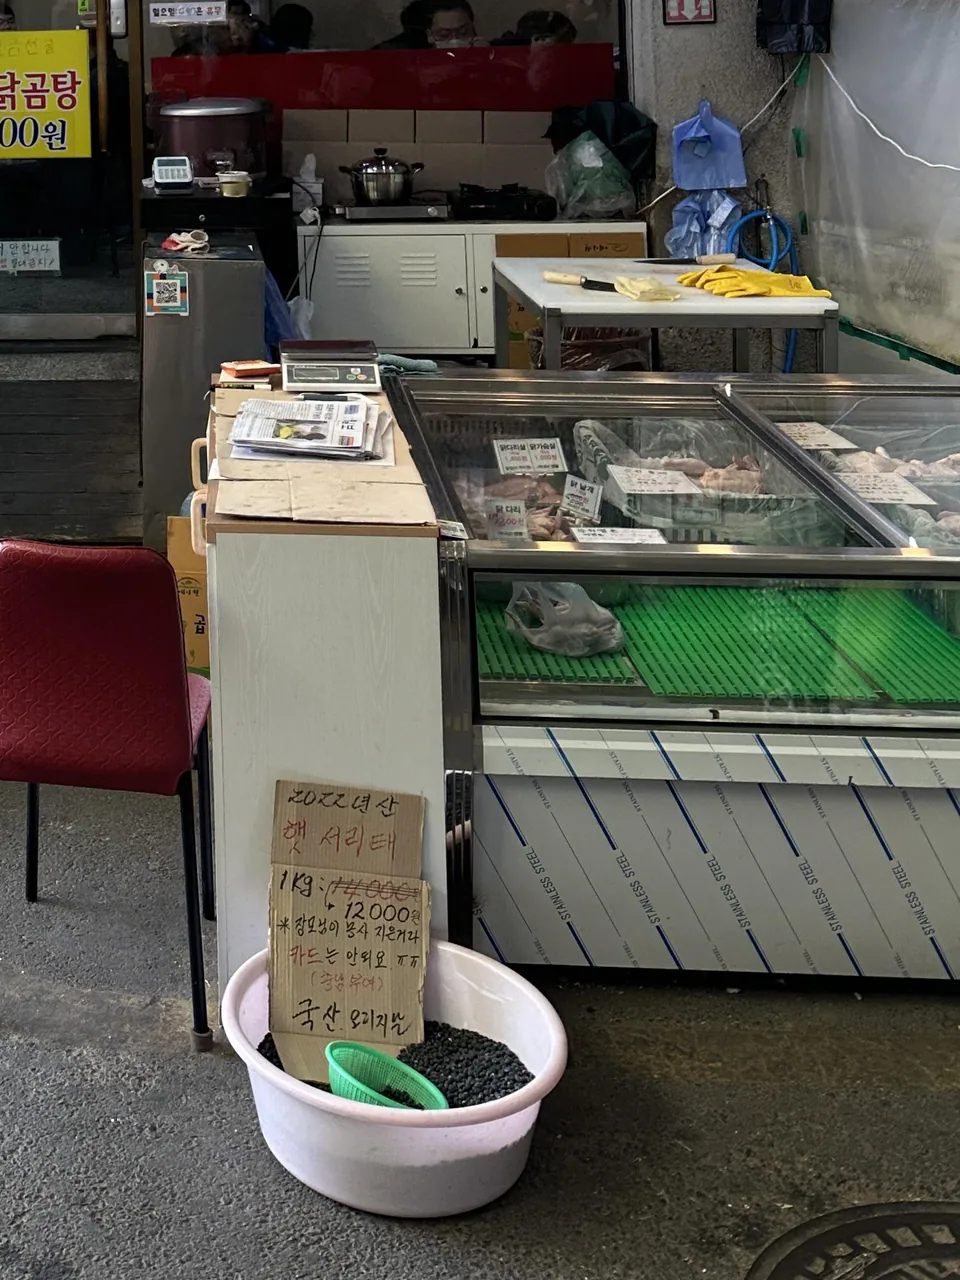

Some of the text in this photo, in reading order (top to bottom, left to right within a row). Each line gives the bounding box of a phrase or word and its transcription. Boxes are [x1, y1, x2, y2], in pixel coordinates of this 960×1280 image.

[283, 820, 396, 860] 햇 서리태
[343, 901, 421, 925] 12000원
[540, 876, 571, 920] STAINLESS
[630, 880, 661, 924] STAINLESS
[720, 883, 751, 927] STAINLESS
[813, 887, 842, 932] STAINLESS
[906, 891, 935, 935] STAINLESS
[295, 913, 340, 939] 장모님이
[291, 998, 342, 1033] 국산
